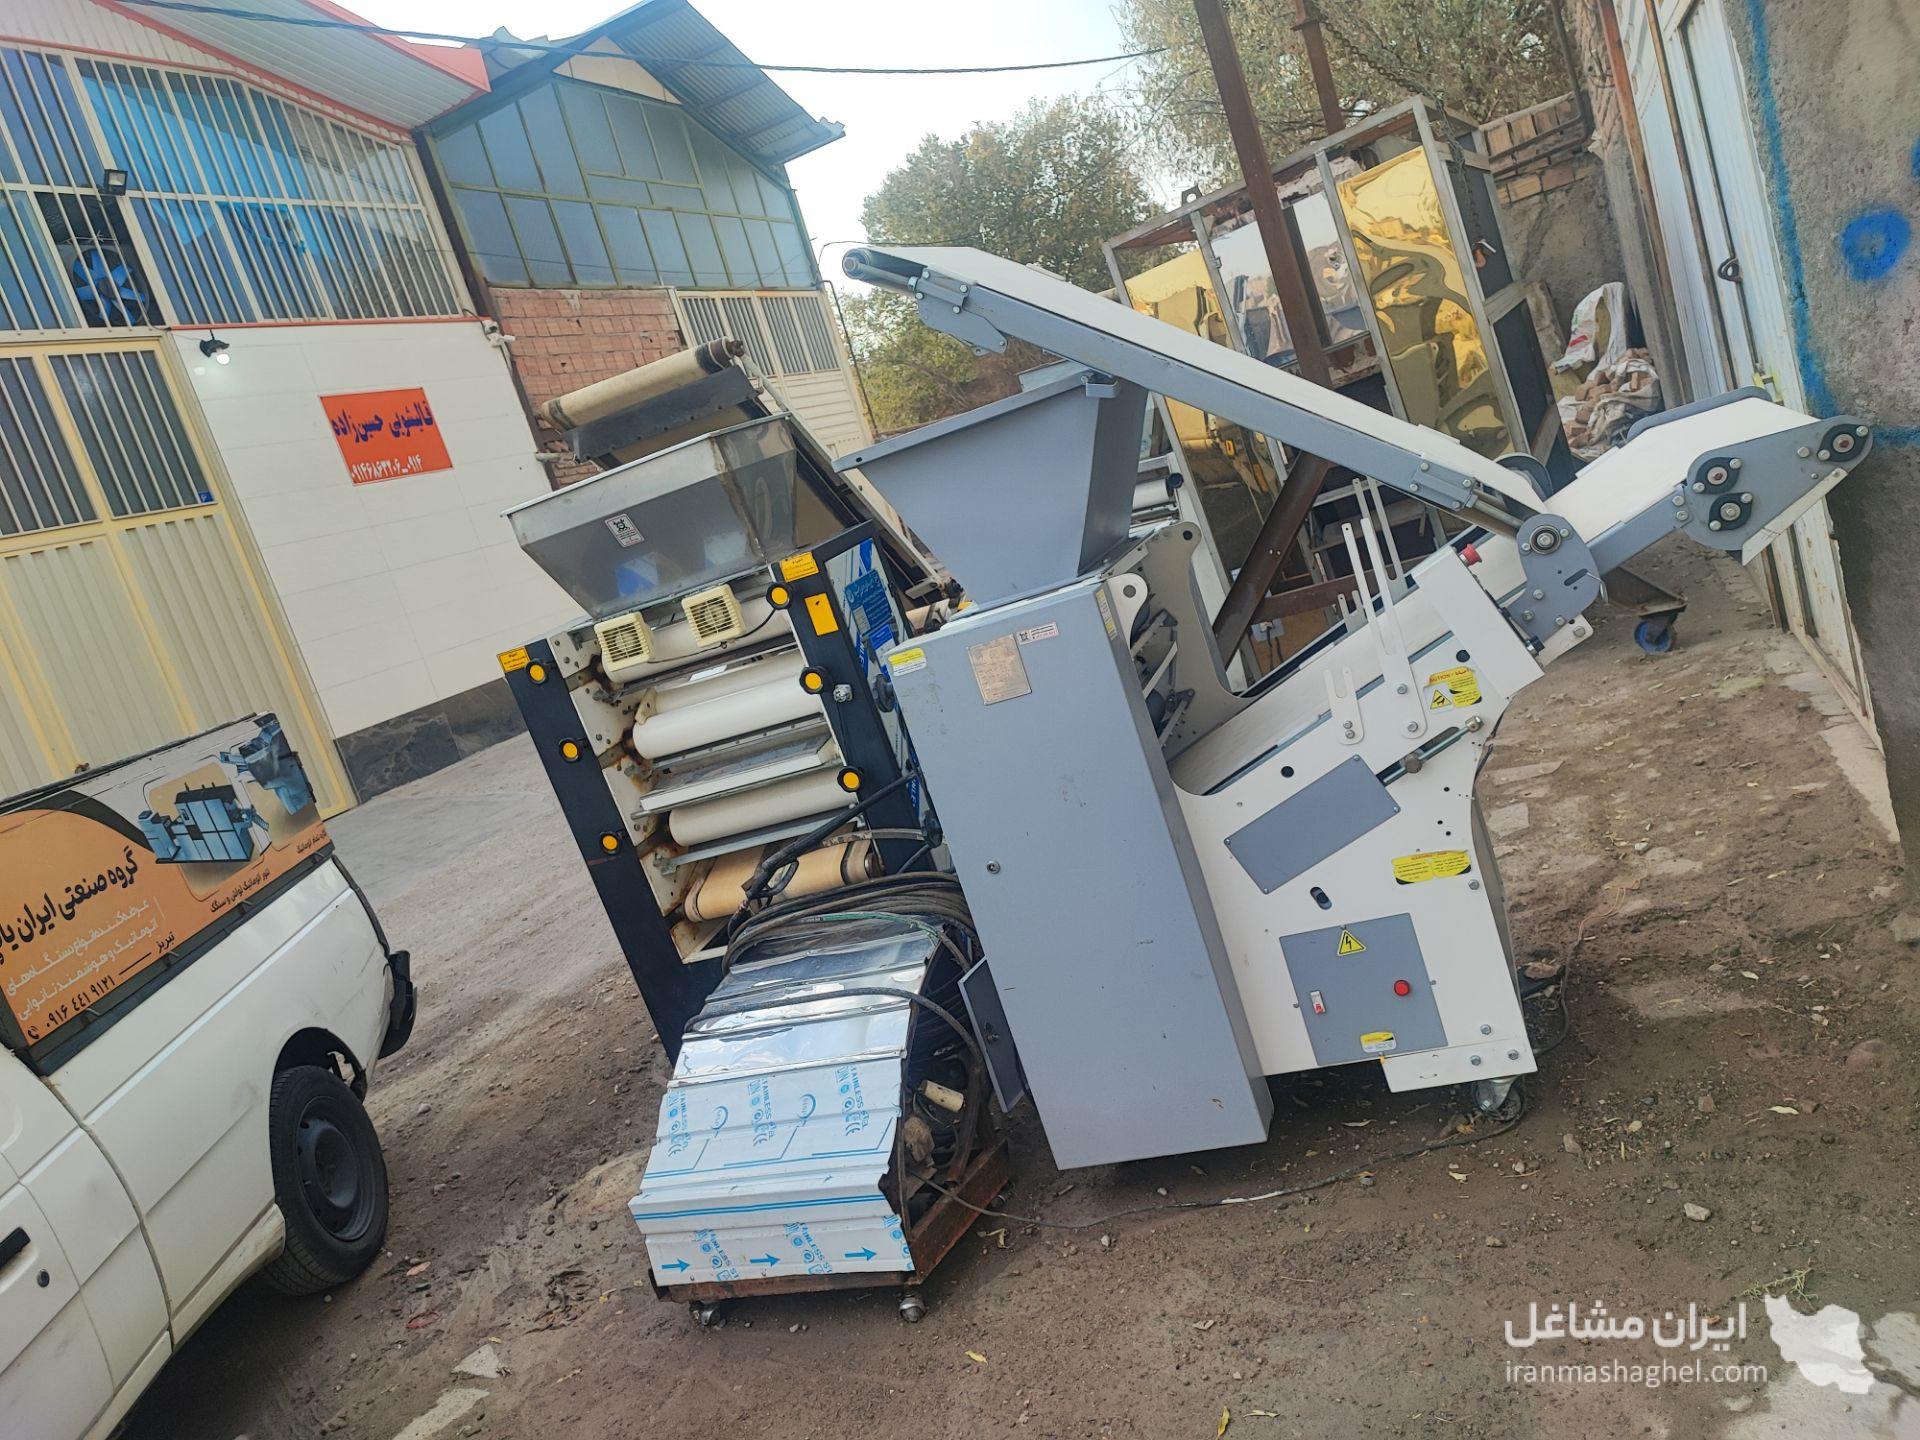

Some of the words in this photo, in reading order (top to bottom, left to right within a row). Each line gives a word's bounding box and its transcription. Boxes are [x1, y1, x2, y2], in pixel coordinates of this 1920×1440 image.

[107, 845, 138, 889] گروه
[58, 874, 108, 921] صنعتی
[17, 892, 57, 943] ایران
[114, 919, 159, 955] اتوماتیک
[156, 931, 175, 954] تبریز
[57, 953, 109, 992] هوشمند
[18, 986, 58, 1021] نانوایی
